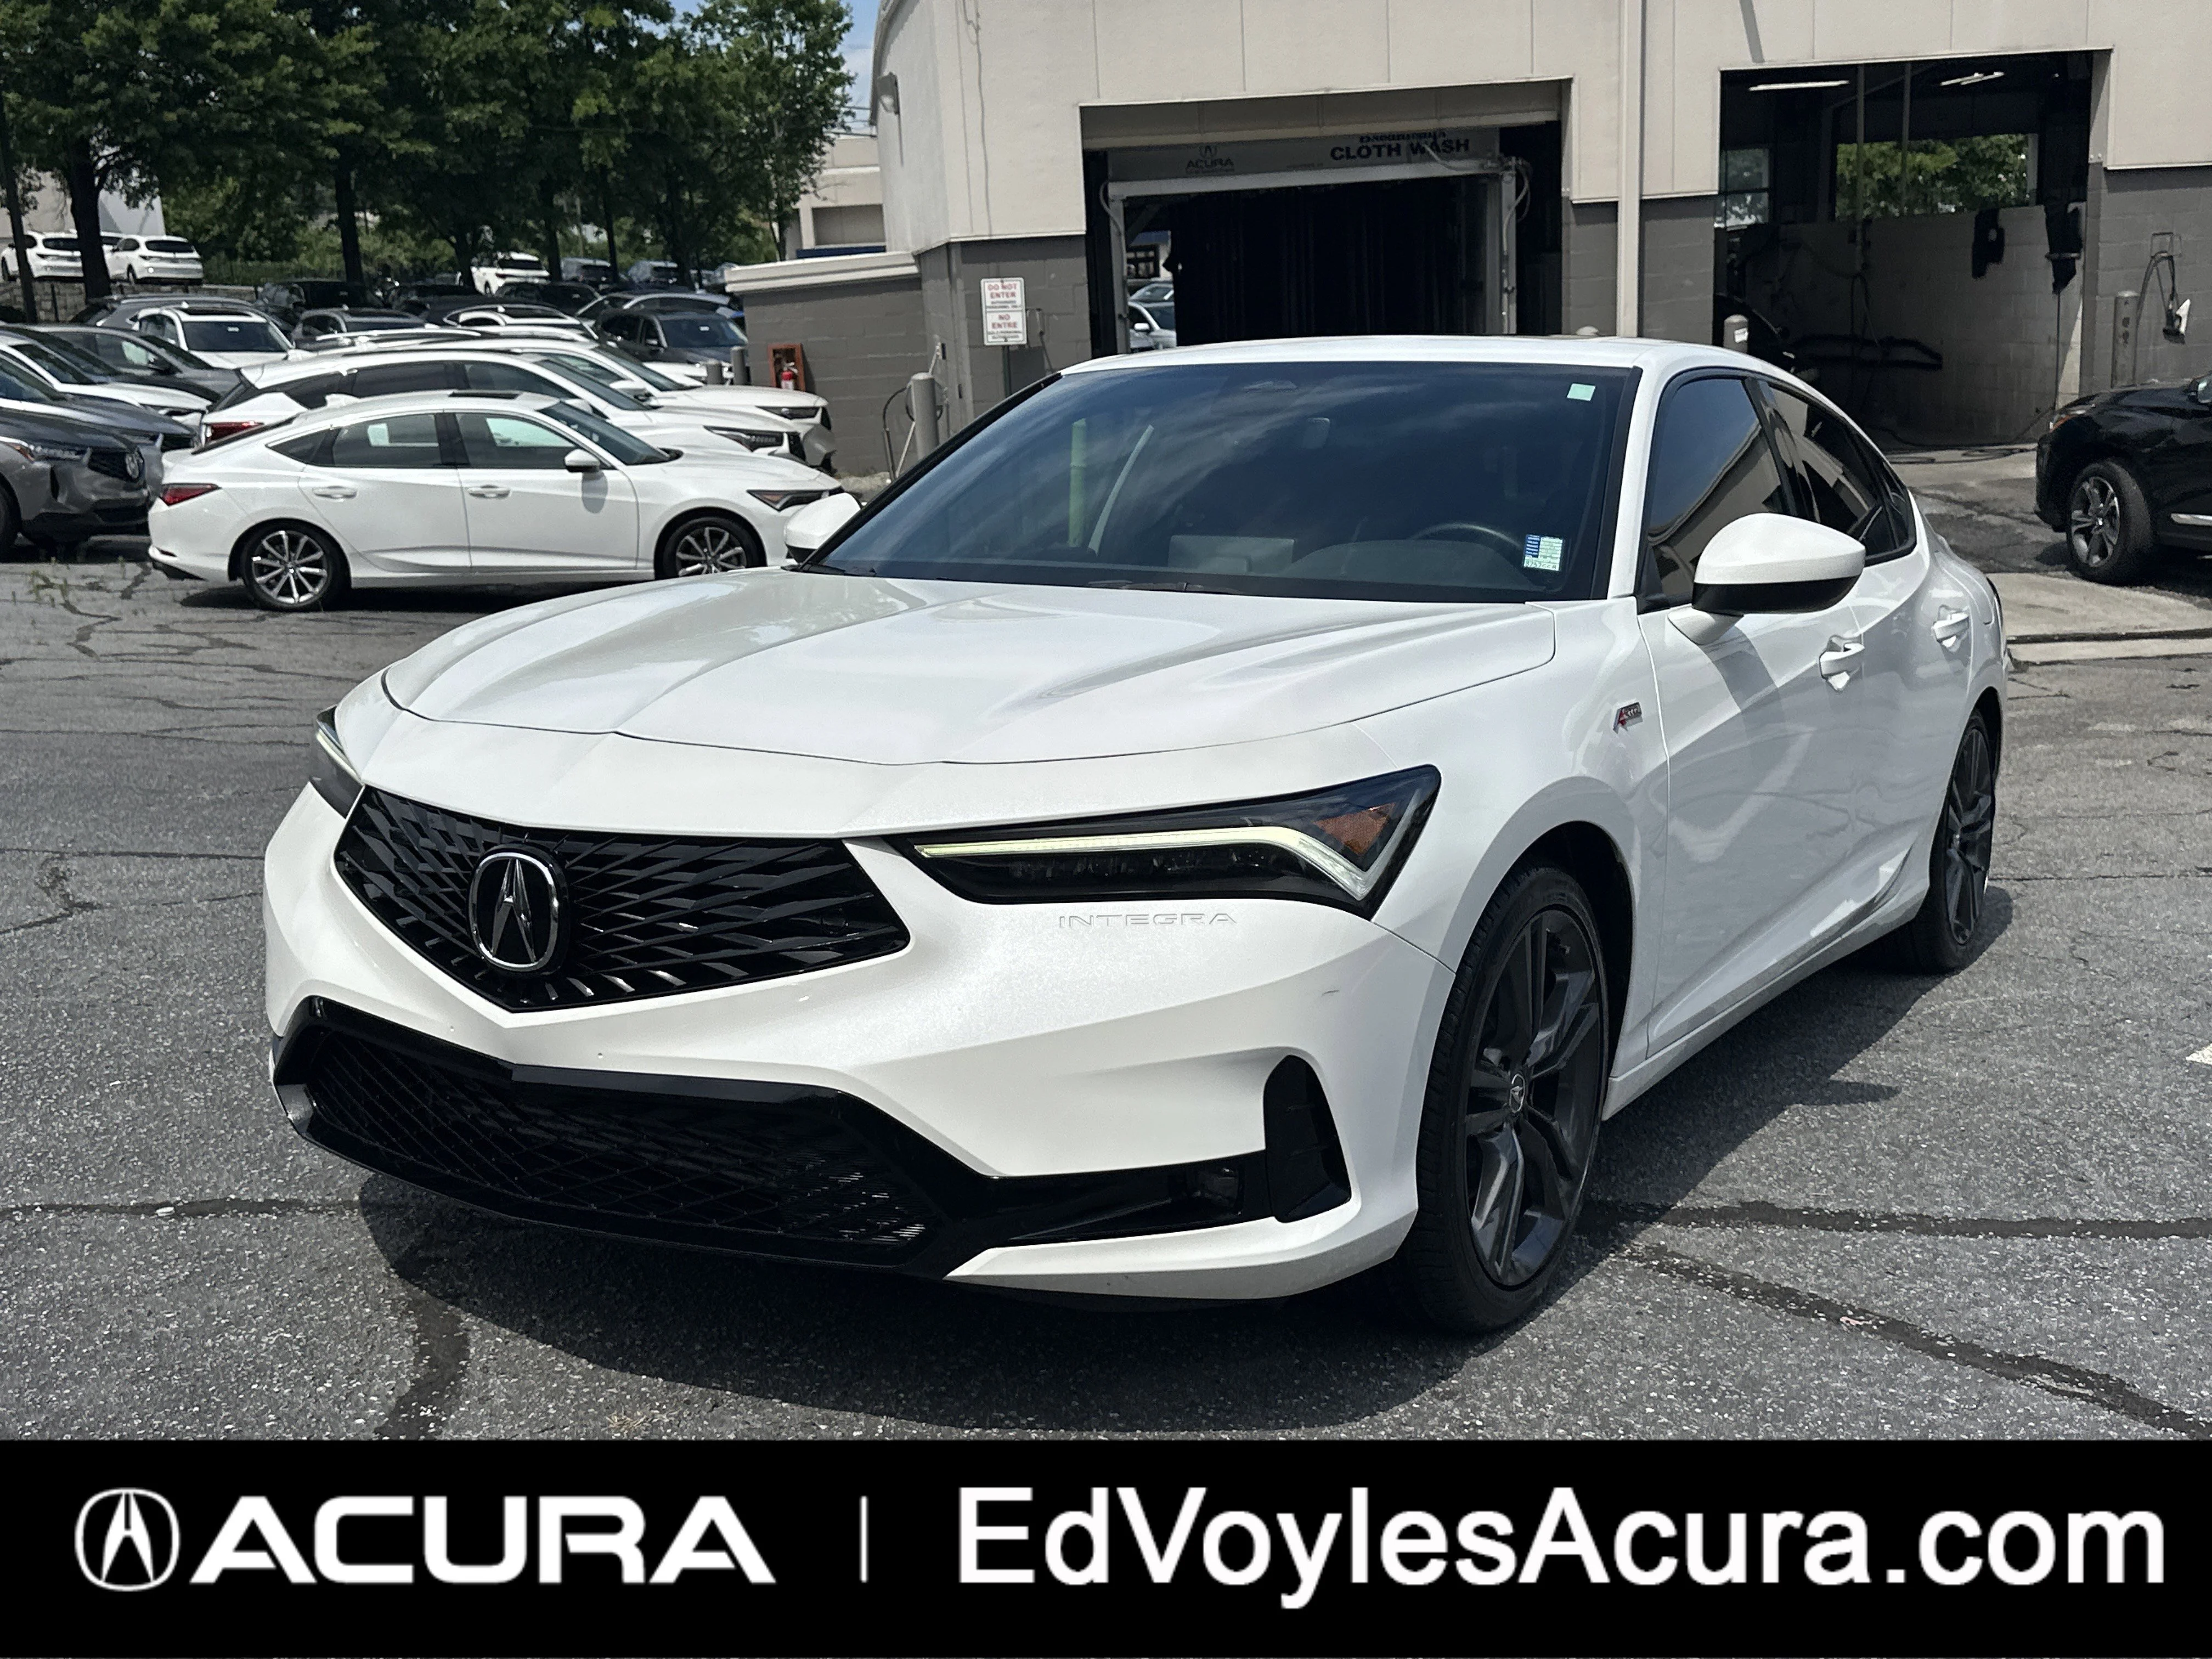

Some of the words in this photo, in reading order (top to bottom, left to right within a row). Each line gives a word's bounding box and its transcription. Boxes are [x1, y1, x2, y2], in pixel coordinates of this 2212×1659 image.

[1330, 143, 1402, 161] CLOTH
[1409, 138, 1470, 155] WASH
[1187, 157, 1235, 169] ACURA
[1059, 913, 1237, 928] INTEGRA
